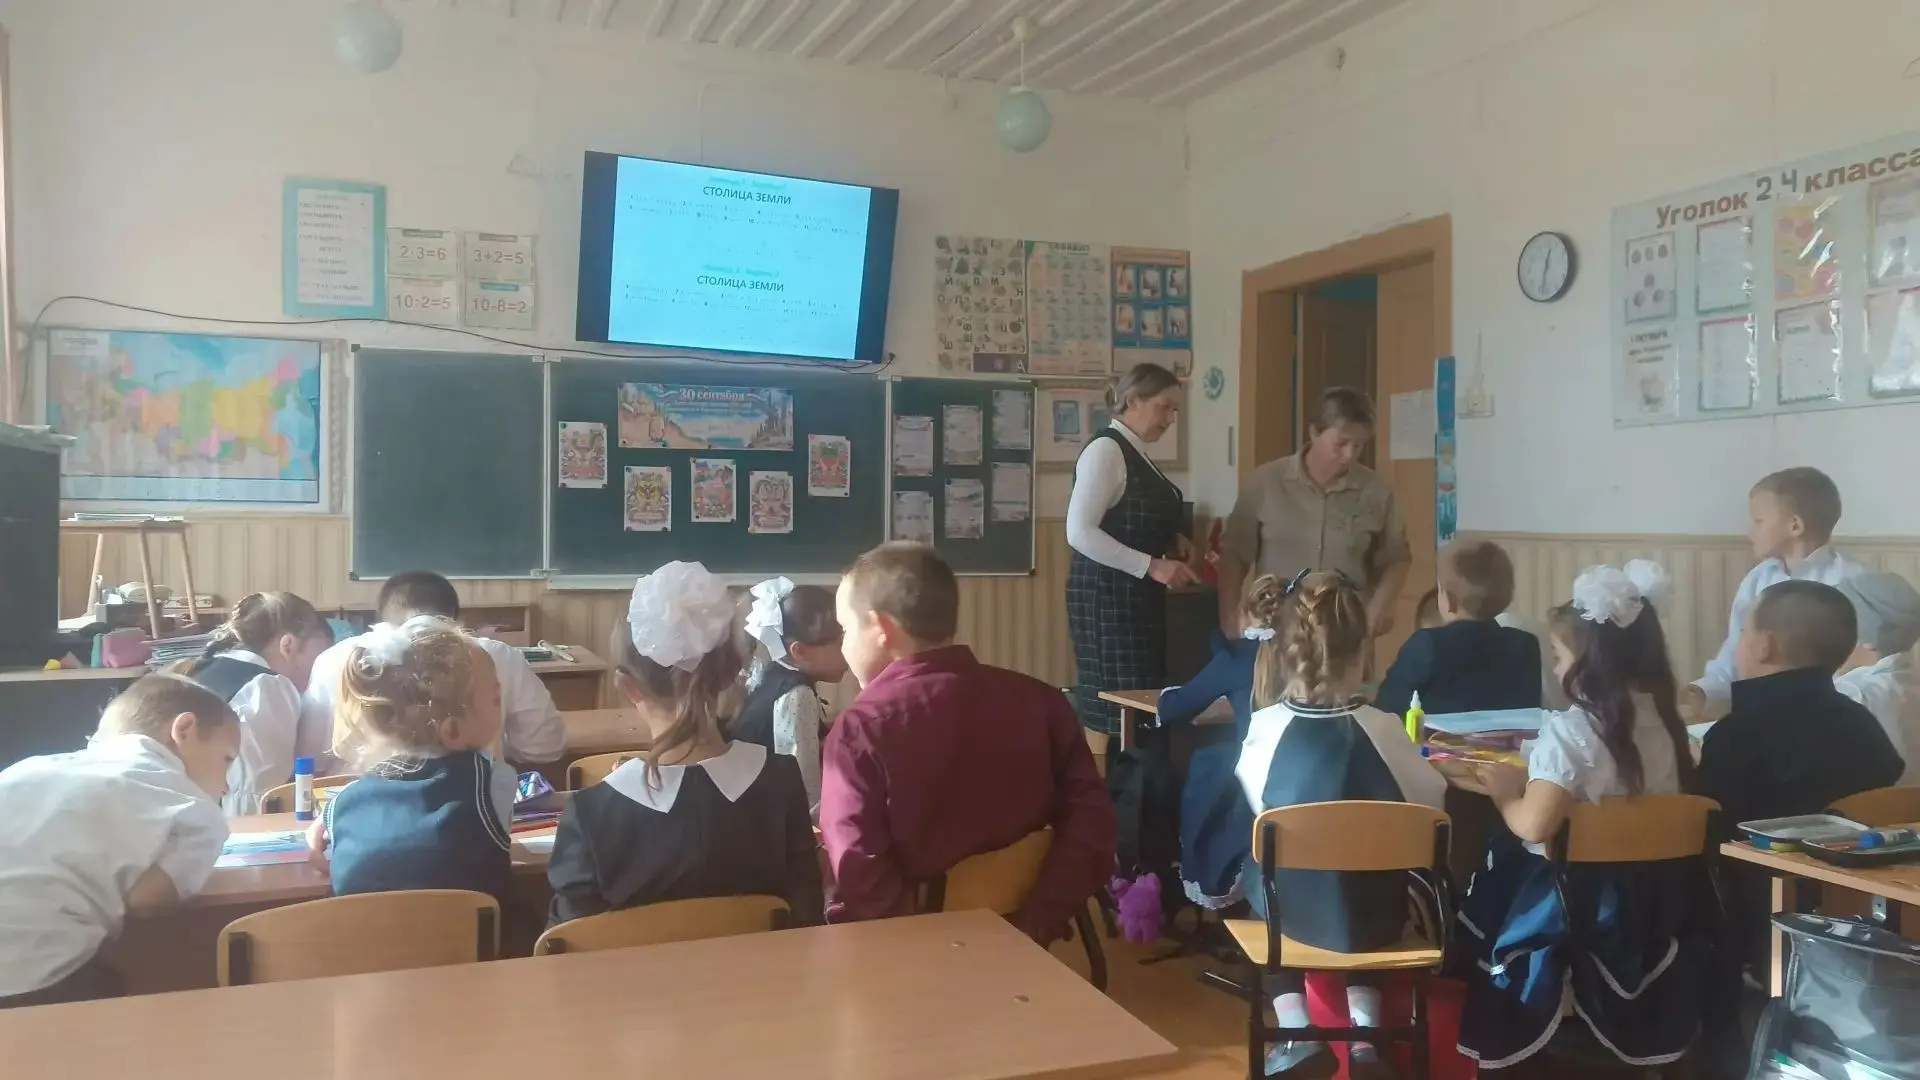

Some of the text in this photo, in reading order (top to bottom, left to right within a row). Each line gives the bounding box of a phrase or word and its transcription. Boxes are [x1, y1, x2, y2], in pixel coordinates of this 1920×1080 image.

[702, 186, 753, 201] СТОЛИЦА
[755, 192, 791, 205] ЗЕМЛИ
[1656, 191, 1749, 229] Уголок
[1805, 148, 1920, 194] класса
[696, 275, 747, 290] СТОЛИЦА
[749, 280, 785, 292] ЗЕМЛИ
[680, 388, 745, 402] 30 сентября
